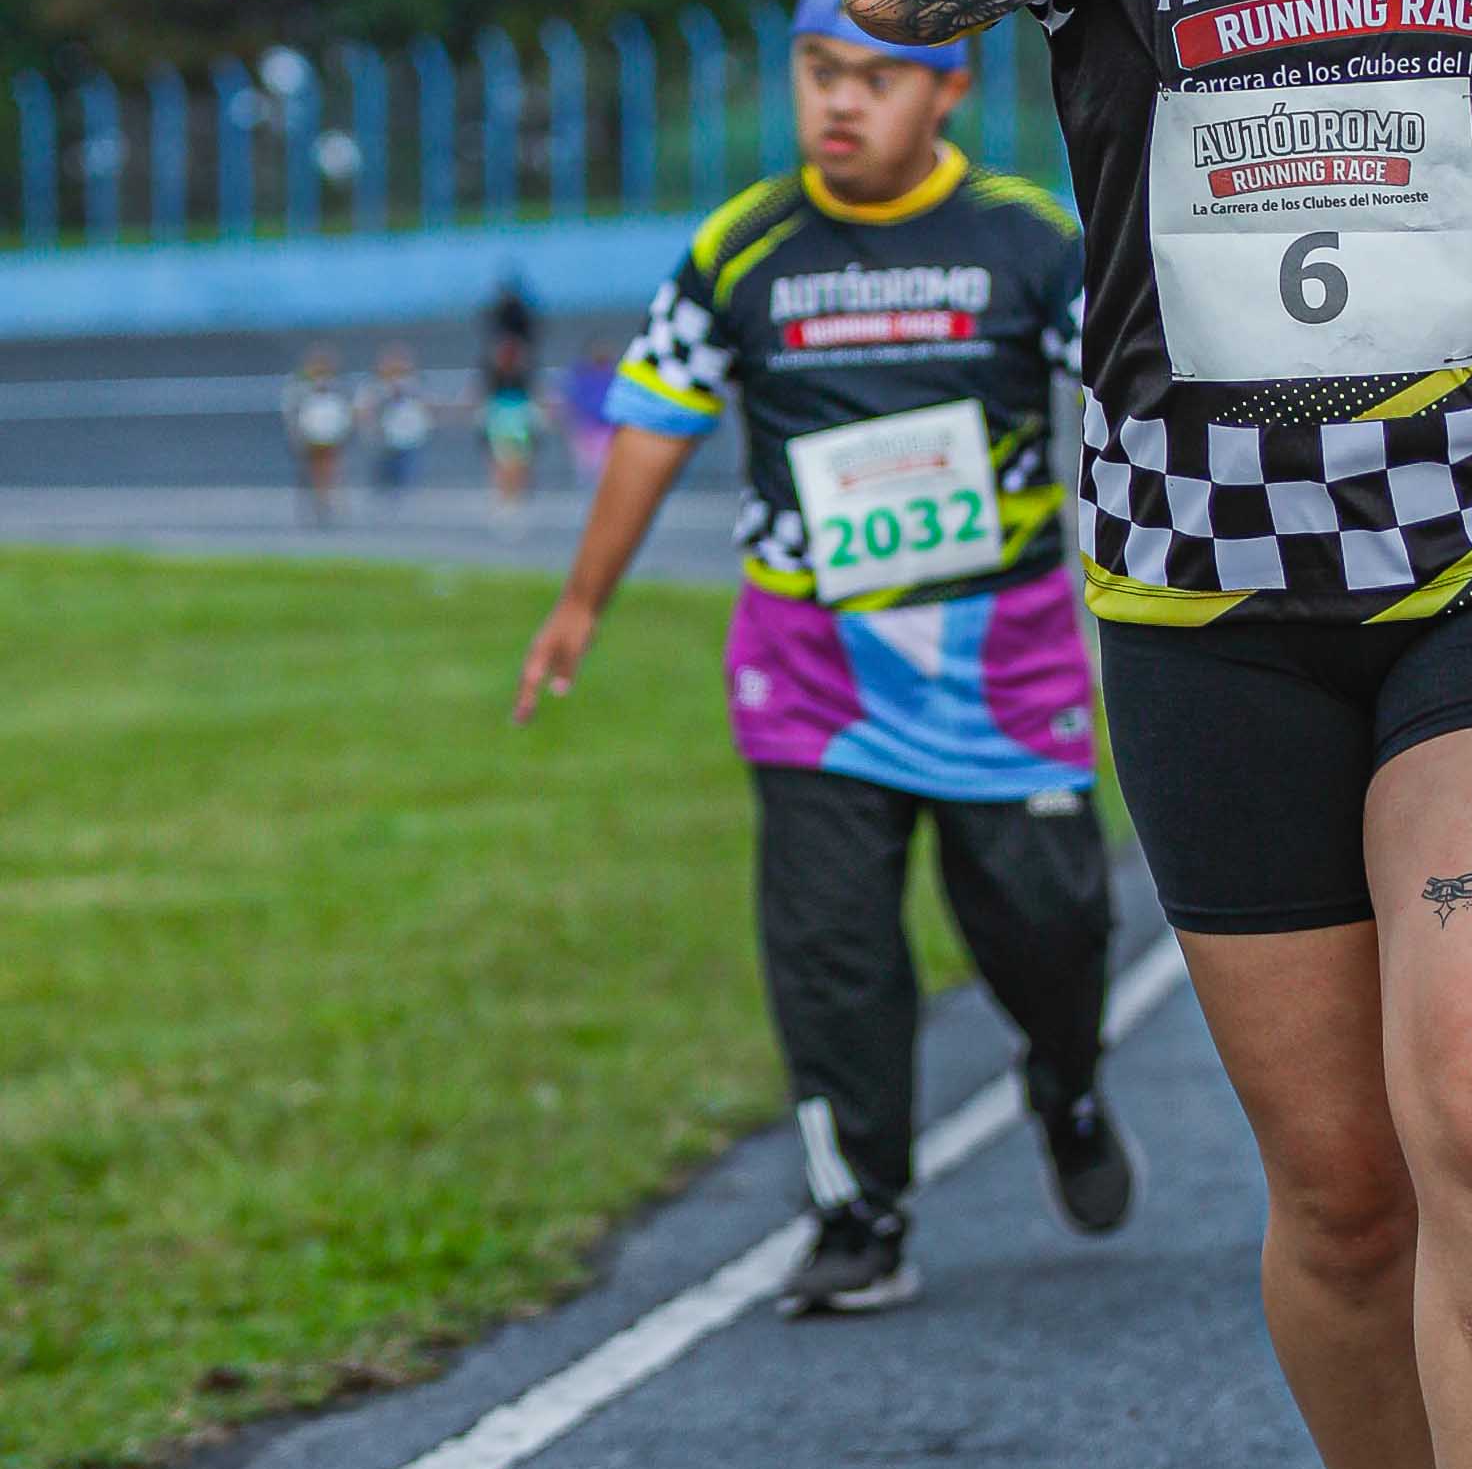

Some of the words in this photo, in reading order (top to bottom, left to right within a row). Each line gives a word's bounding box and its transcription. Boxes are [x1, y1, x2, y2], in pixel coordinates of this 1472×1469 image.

[1272, 64, 1302, 87] de
[1307, 60, 1342, 83] los
[1347, 51, 1421, 78] Clubes
[1427, 50, 1462, 74] del
[1193, 102, 1426, 168] AUTÓDROMO
[1232, 159, 1326, 193] RUNNING
[1333, 158, 1387, 184] RACE
[1192, 203, 1208, 215] La
[1211, 202, 1259, 215] Carrera
[1262, 199, 1279, 212] de
[1281, 198, 1300, 211] los
[1303, 196, 1347, 210] Clubes
[1350, 193, 1370, 207] del
[1372, 191, 1430, 205] Noroeste
[1279, 231, 1349, 325] 6
[821, 488, 988, 569] 2032
